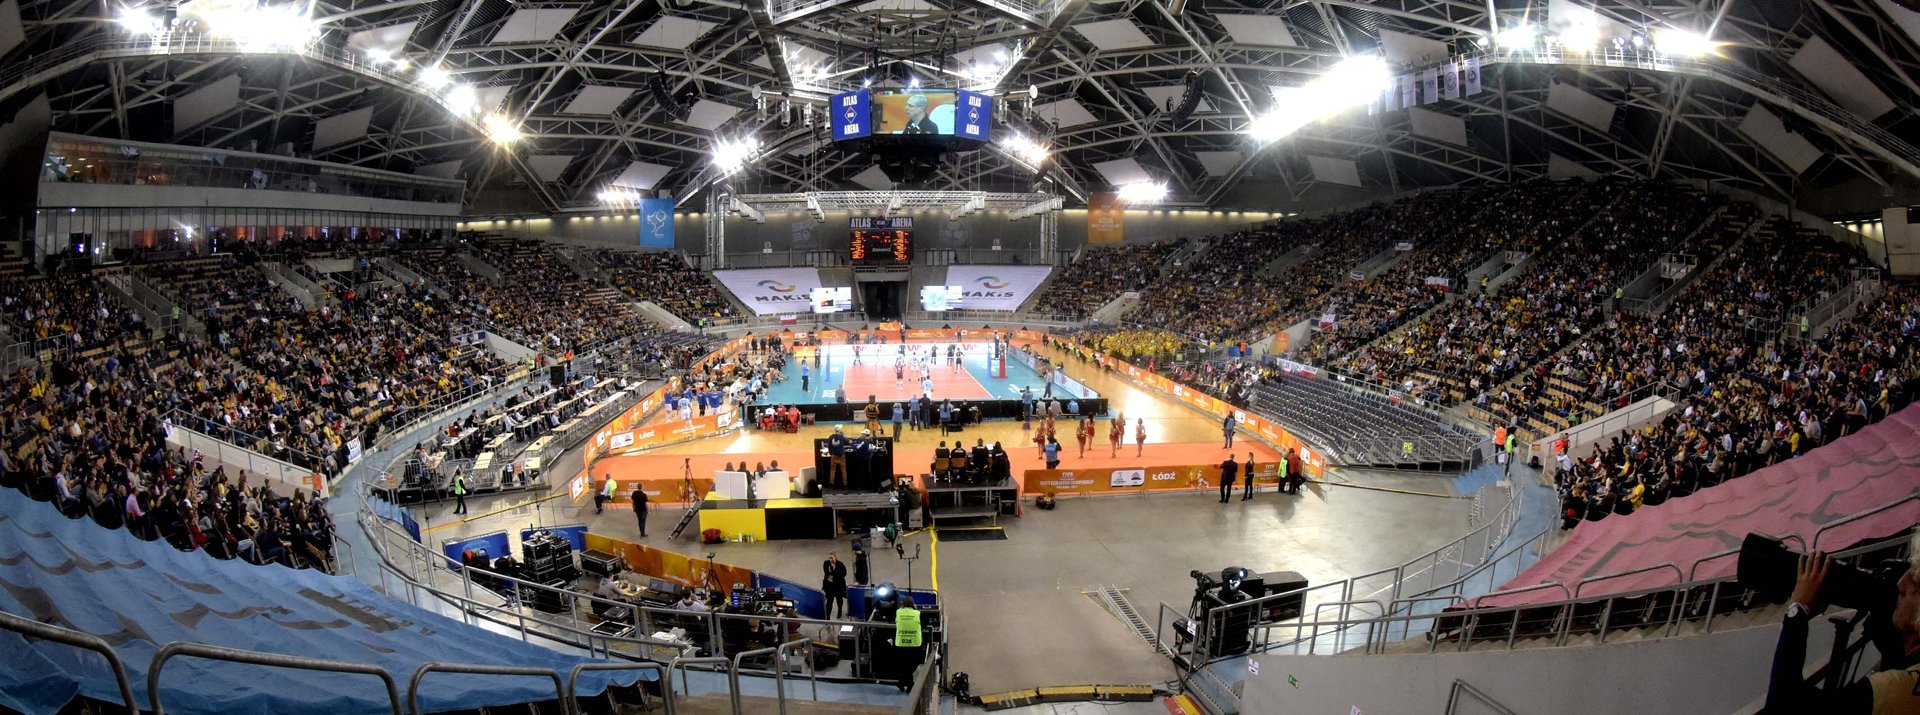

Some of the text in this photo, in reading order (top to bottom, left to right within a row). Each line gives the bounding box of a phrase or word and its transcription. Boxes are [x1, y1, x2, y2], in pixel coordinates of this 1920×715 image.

[843, 95, 858, 107] ATLAS
[968, 95, 982, 107] ATLAS
[844, 123, 860, 135] ARENA
[966, 123, 980, 135] ARENA
[851, 218, 871, 228] ATLAS
[891, 217, 913, 227] ARENA
